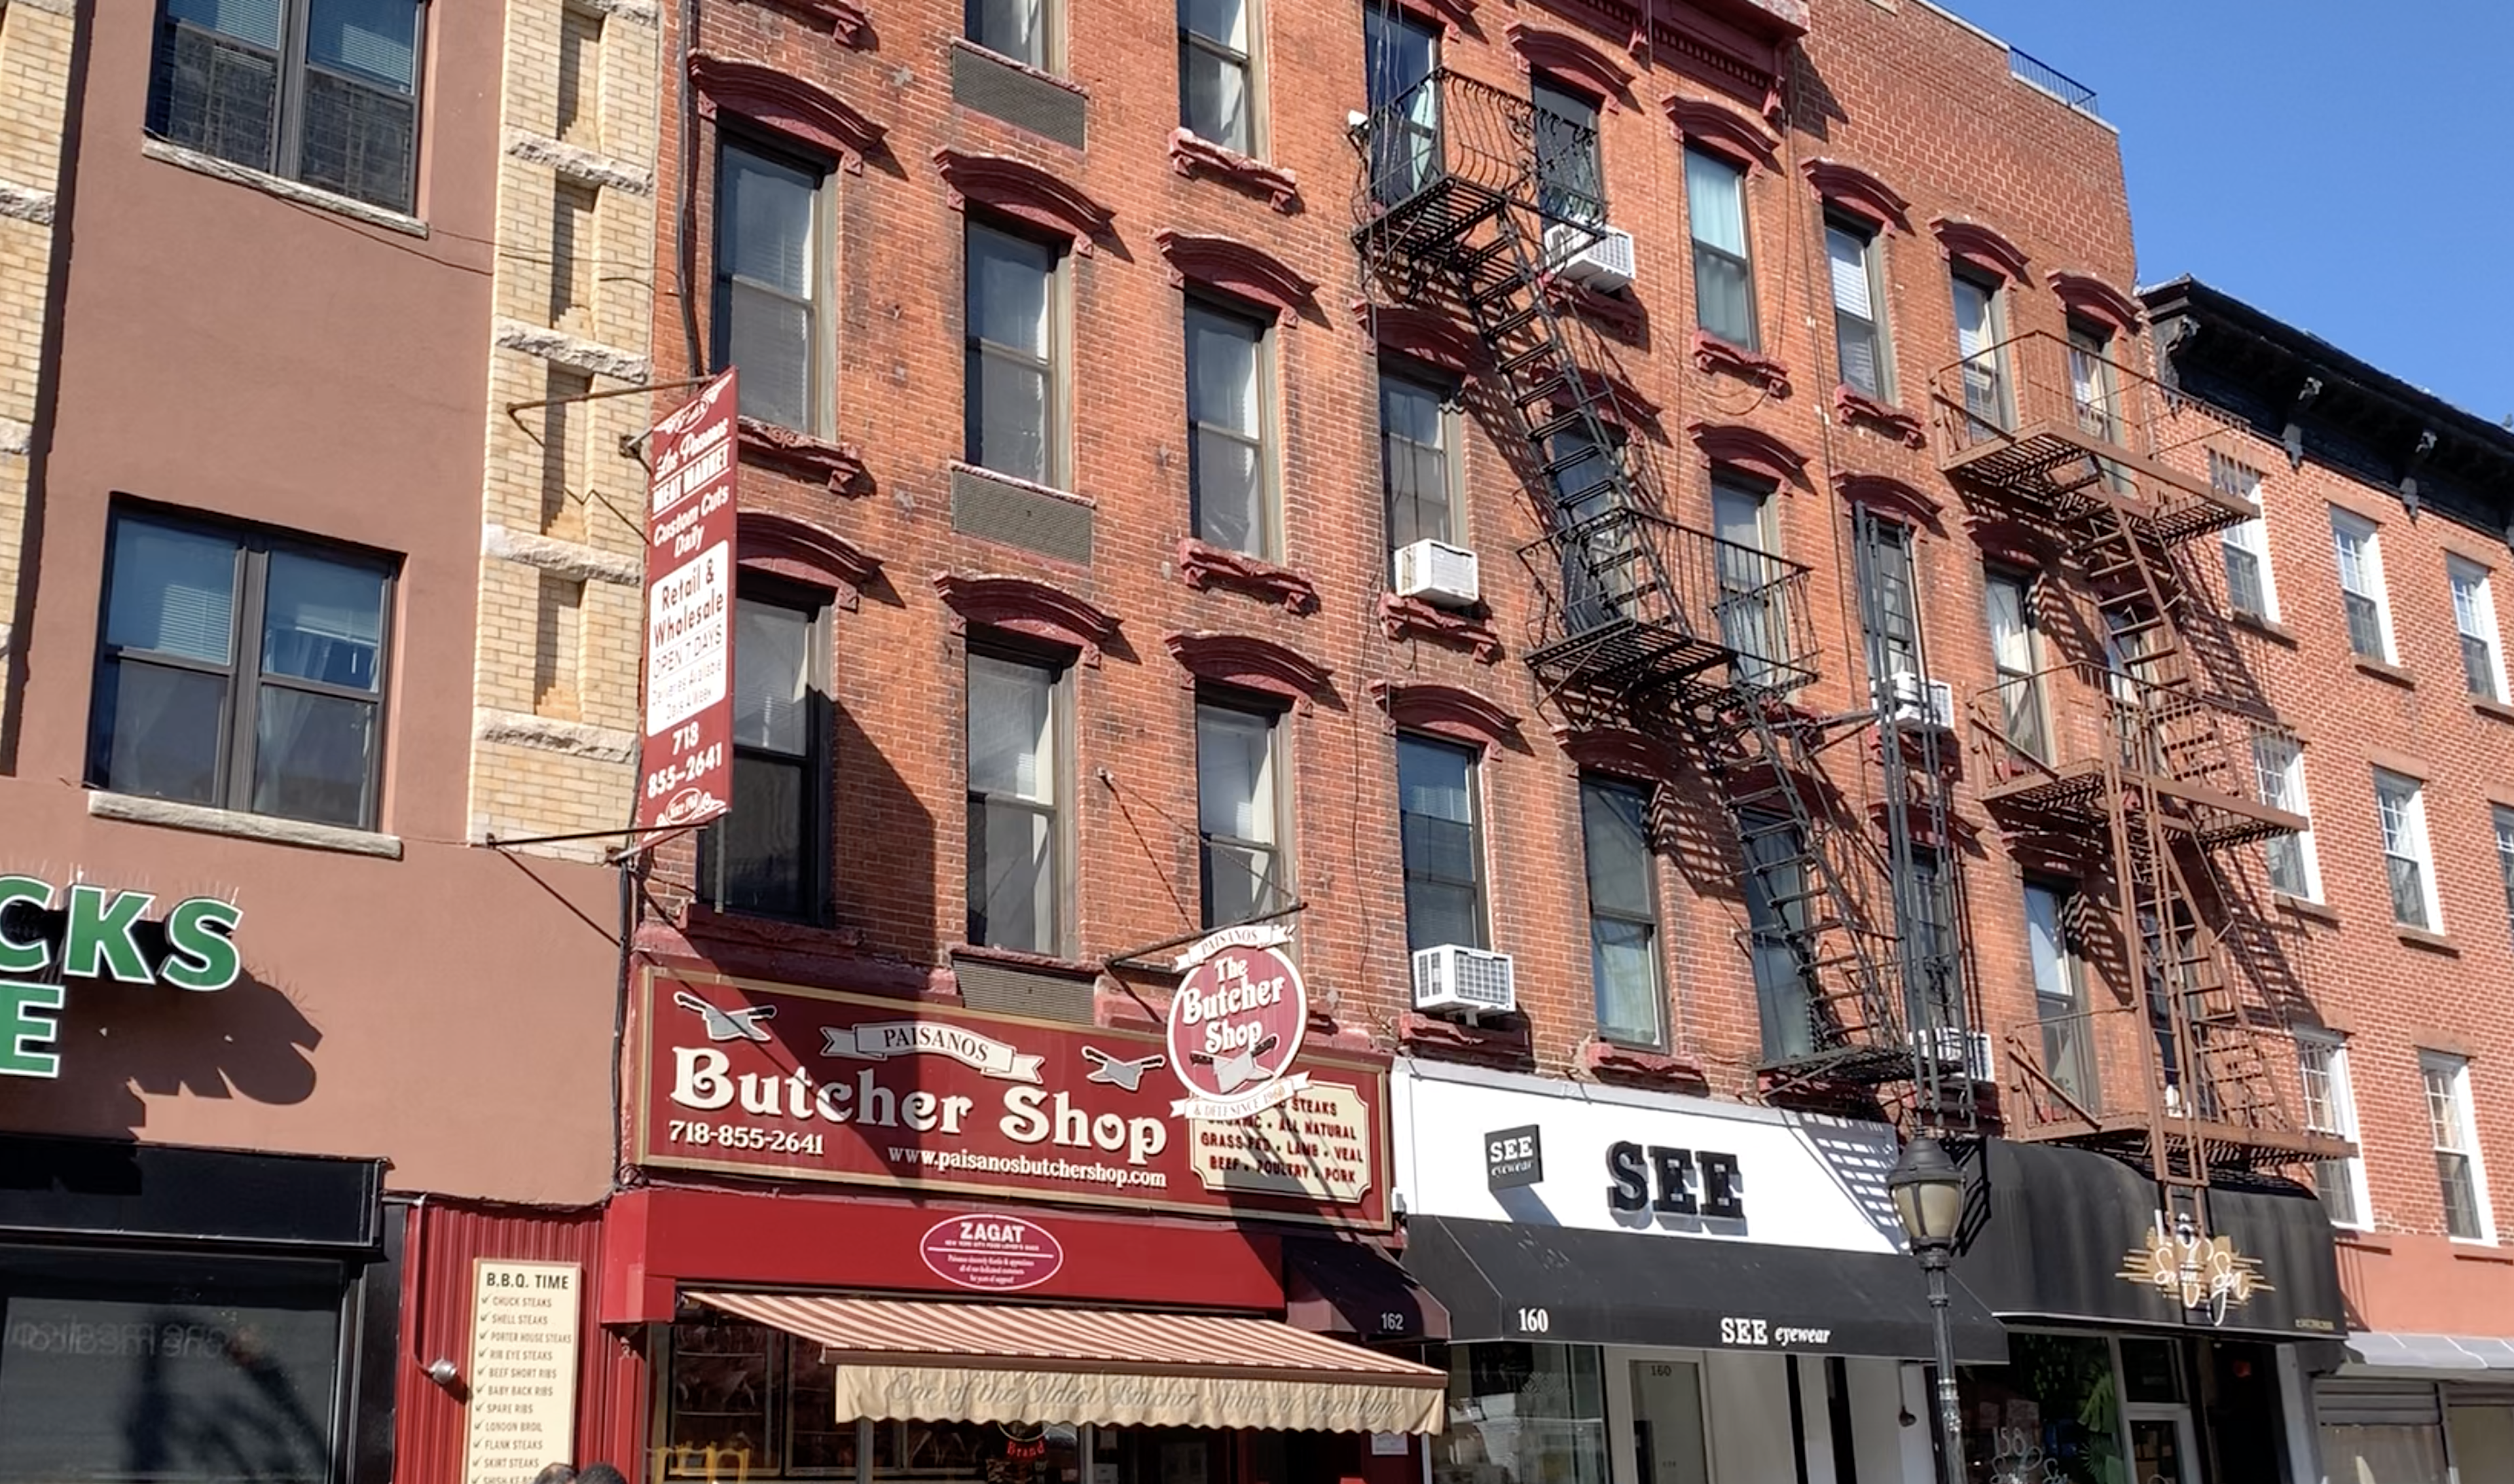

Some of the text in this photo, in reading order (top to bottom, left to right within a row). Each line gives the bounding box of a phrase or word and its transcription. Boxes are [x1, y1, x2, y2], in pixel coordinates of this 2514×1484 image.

[653, 443, 729, 514] MEAT MARKET
[653, 486, 729, 547] Custom Cuts
[674, 524, 705, 558] Daily
[663, 558, 714, 611] Retail &
[654, 588, 723, 648] Wholesale
[653, 624, 722, 679] OPEN 7 DAYS
[673, 721, 699, 755] 718
[647, 742, 722, 799] 855-2641
[1200, 928, 1258, 956] PAISANOS
[1214, 955, 1248, 983] The
[1182, 975, 1285, 1024] Butcher
[883, 1026, 989, 1063] PAISANOS
[1205, 1019, 1262, 1054] Shop
[670, 1045, 1167, 1166] Butcher Shop
[1292, 1095, 1337, 1117] STEAKS
[668, 1119, 825, 1155] 718-855-2641
[1279, 1117, 1299, 1134] ALL
[1304, 1120, 1357, 1141] NATURAL
[1286, 1139, 1319, 1157] LAMB
[1334, 1146, 1364, 1163] VEAL
[1490, 1135, 1533, 1163] SEE
[888, 1146, 1168, 1189] www.paisanosbutchershop.com
[1209, 1154, 1356, 1184] BEEF POULTRY PORK
[1606, 1140, 1744, 1218] SEE
[960, 1221, 1026, 1243] ZAGAT
[486, 1273, 569, 1290] B.B.Q. TIME
[492, 1295, 552, 1308] CHUCK STEAKS
[492, 1313, 548, 1326] SHELL STEAKS
[1381, 1312, 1404, 1331] 162
[1518, 1308, 1550, 1333] 160
[1721, 1316, 1832, 1347] SEE eyewear
[491, 1331, 572, 1344] PORTER HOUSE STEAKS
[490, 1349, 553, 1362] RIB EYE STEAKS
[488, 1367, 558, 1380] BEEF SHORT RIBS
[1650, 1365, 1672, 1377] 160
[488, 1385, 554, 1397] BABY BACK RIBS
[888, 1371, 939, 1402] One
[949, 1380, 973, 1412] of
[977, 1380, 1022, 1405] the
[1026, 1375, 1099, 1405] Oldest
[486, 1403, 534, 1415] SPARE RIBS
[485, 1421, 543, 1433] LONDON BROIL
[484, 1439, 543, 1451] FLANK STEAKS
[1006, 1439, 1046, 1458] Brand
[484, 1457, 540, 1469] SKIRT STEAKS
